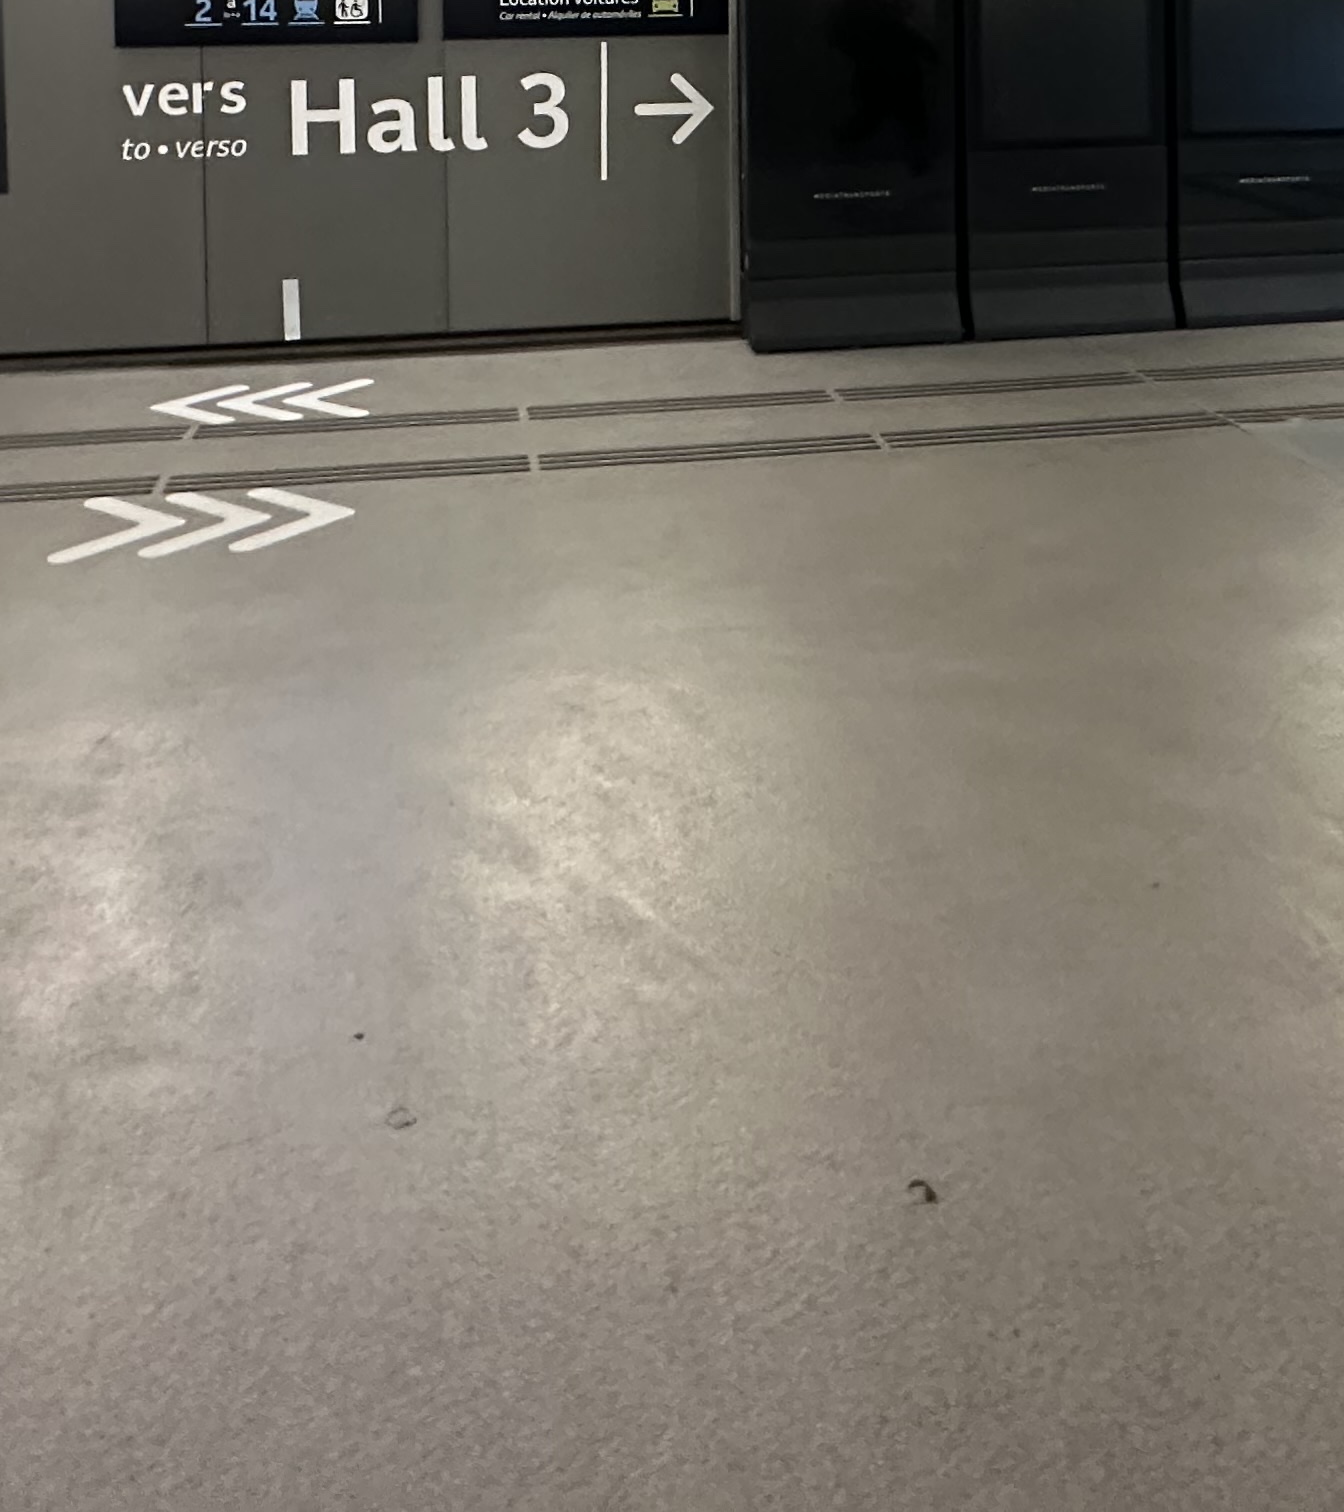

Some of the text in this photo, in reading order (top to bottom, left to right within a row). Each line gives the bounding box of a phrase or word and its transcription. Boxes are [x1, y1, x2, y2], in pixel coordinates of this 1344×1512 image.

[122, 72, 570, 156] vers Hall 3
[121, 136, 247, 160] to verso
